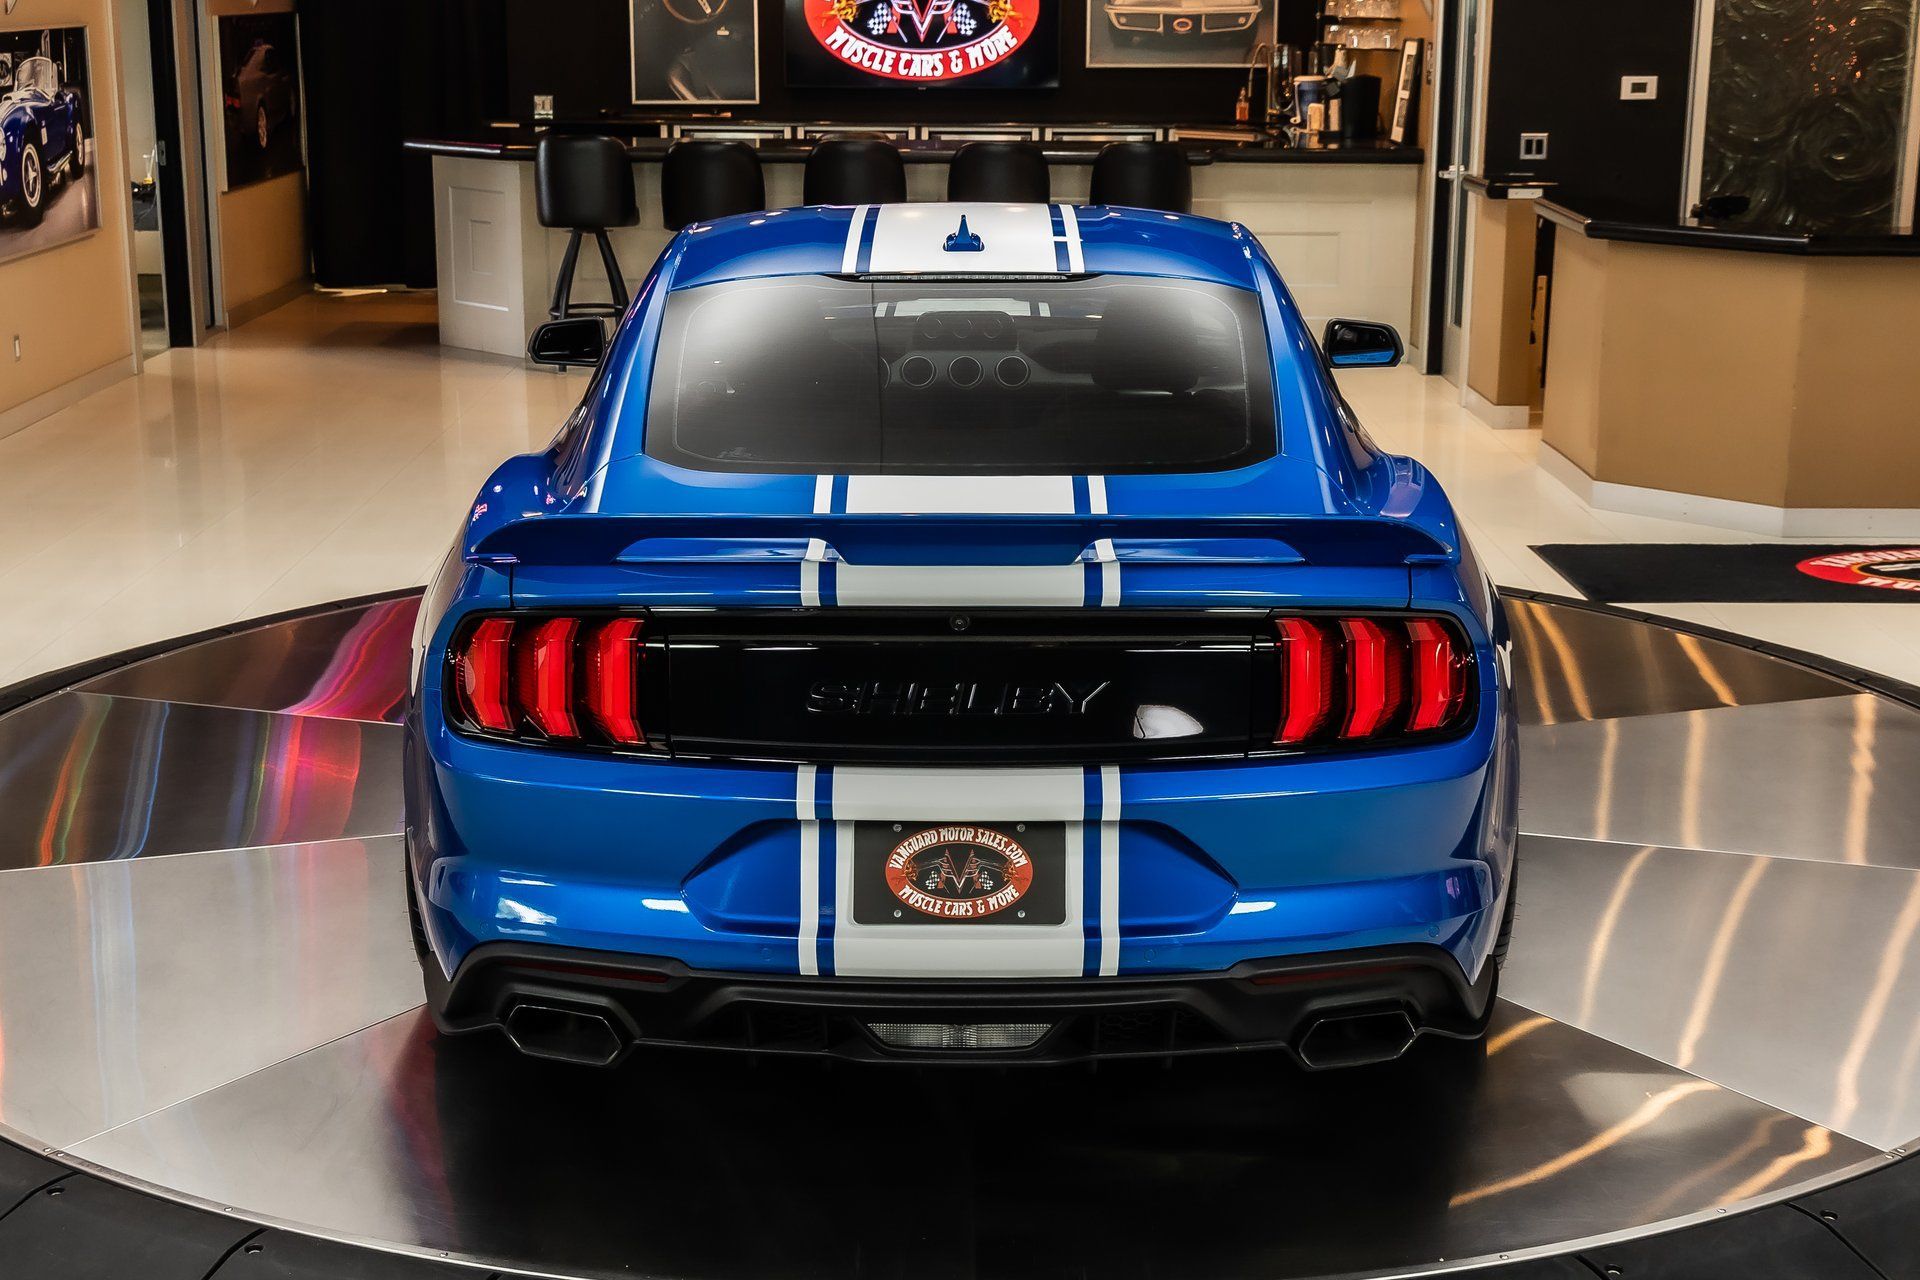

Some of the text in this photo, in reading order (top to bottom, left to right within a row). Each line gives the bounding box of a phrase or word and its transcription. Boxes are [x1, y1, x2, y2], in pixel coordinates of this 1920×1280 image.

[824, 25, 1018, 77] MUSCLE CARS & MORE
[806, 680, 1110, 714] SHELBY
[889, 827, 1028, 869] VANGUARD MOTOR SALES.COM
[898, 885, 1020, 916] MUSCLE CARS & MORE
